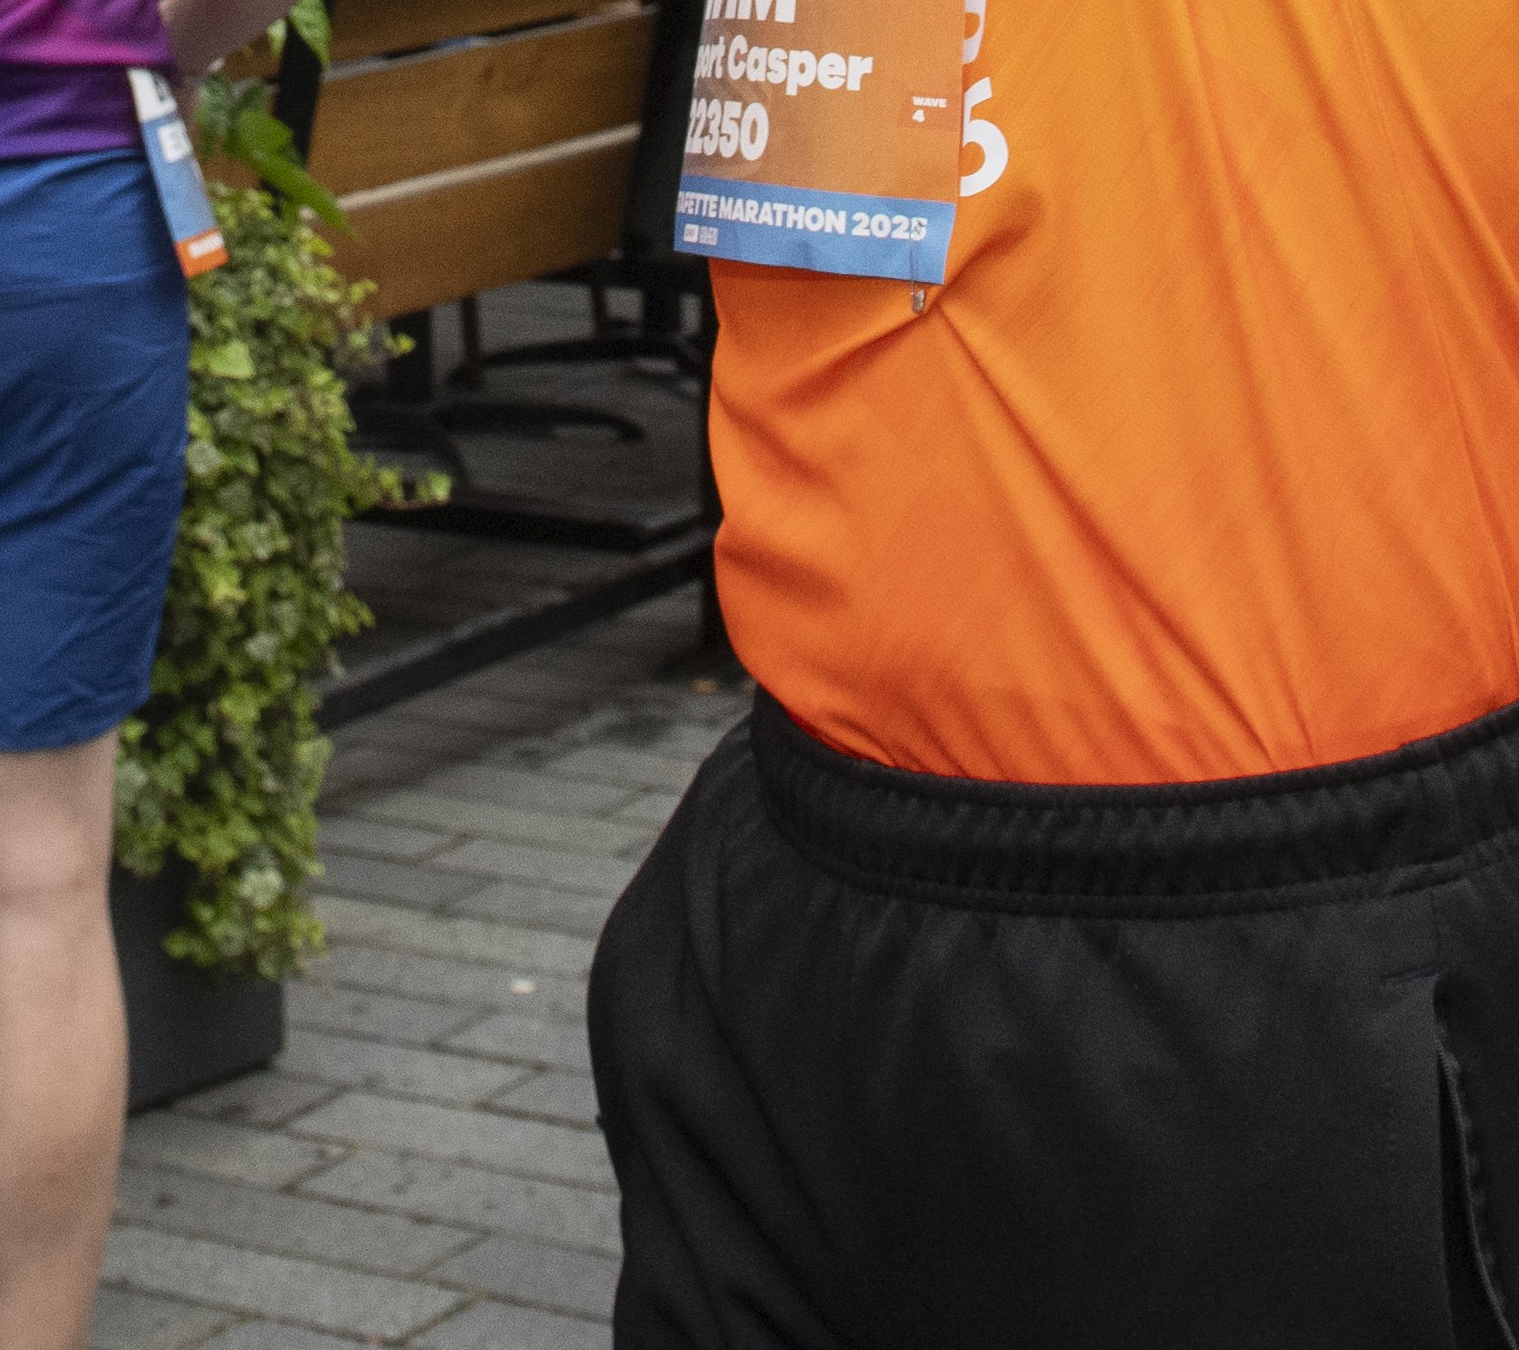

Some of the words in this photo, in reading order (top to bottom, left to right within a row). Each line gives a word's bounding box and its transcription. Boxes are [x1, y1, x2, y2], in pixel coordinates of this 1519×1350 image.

[727, 33, 874, 97] Casper
[719, 195, 847, 235] MARATHON
[850, 211, 929, 241] 2025
